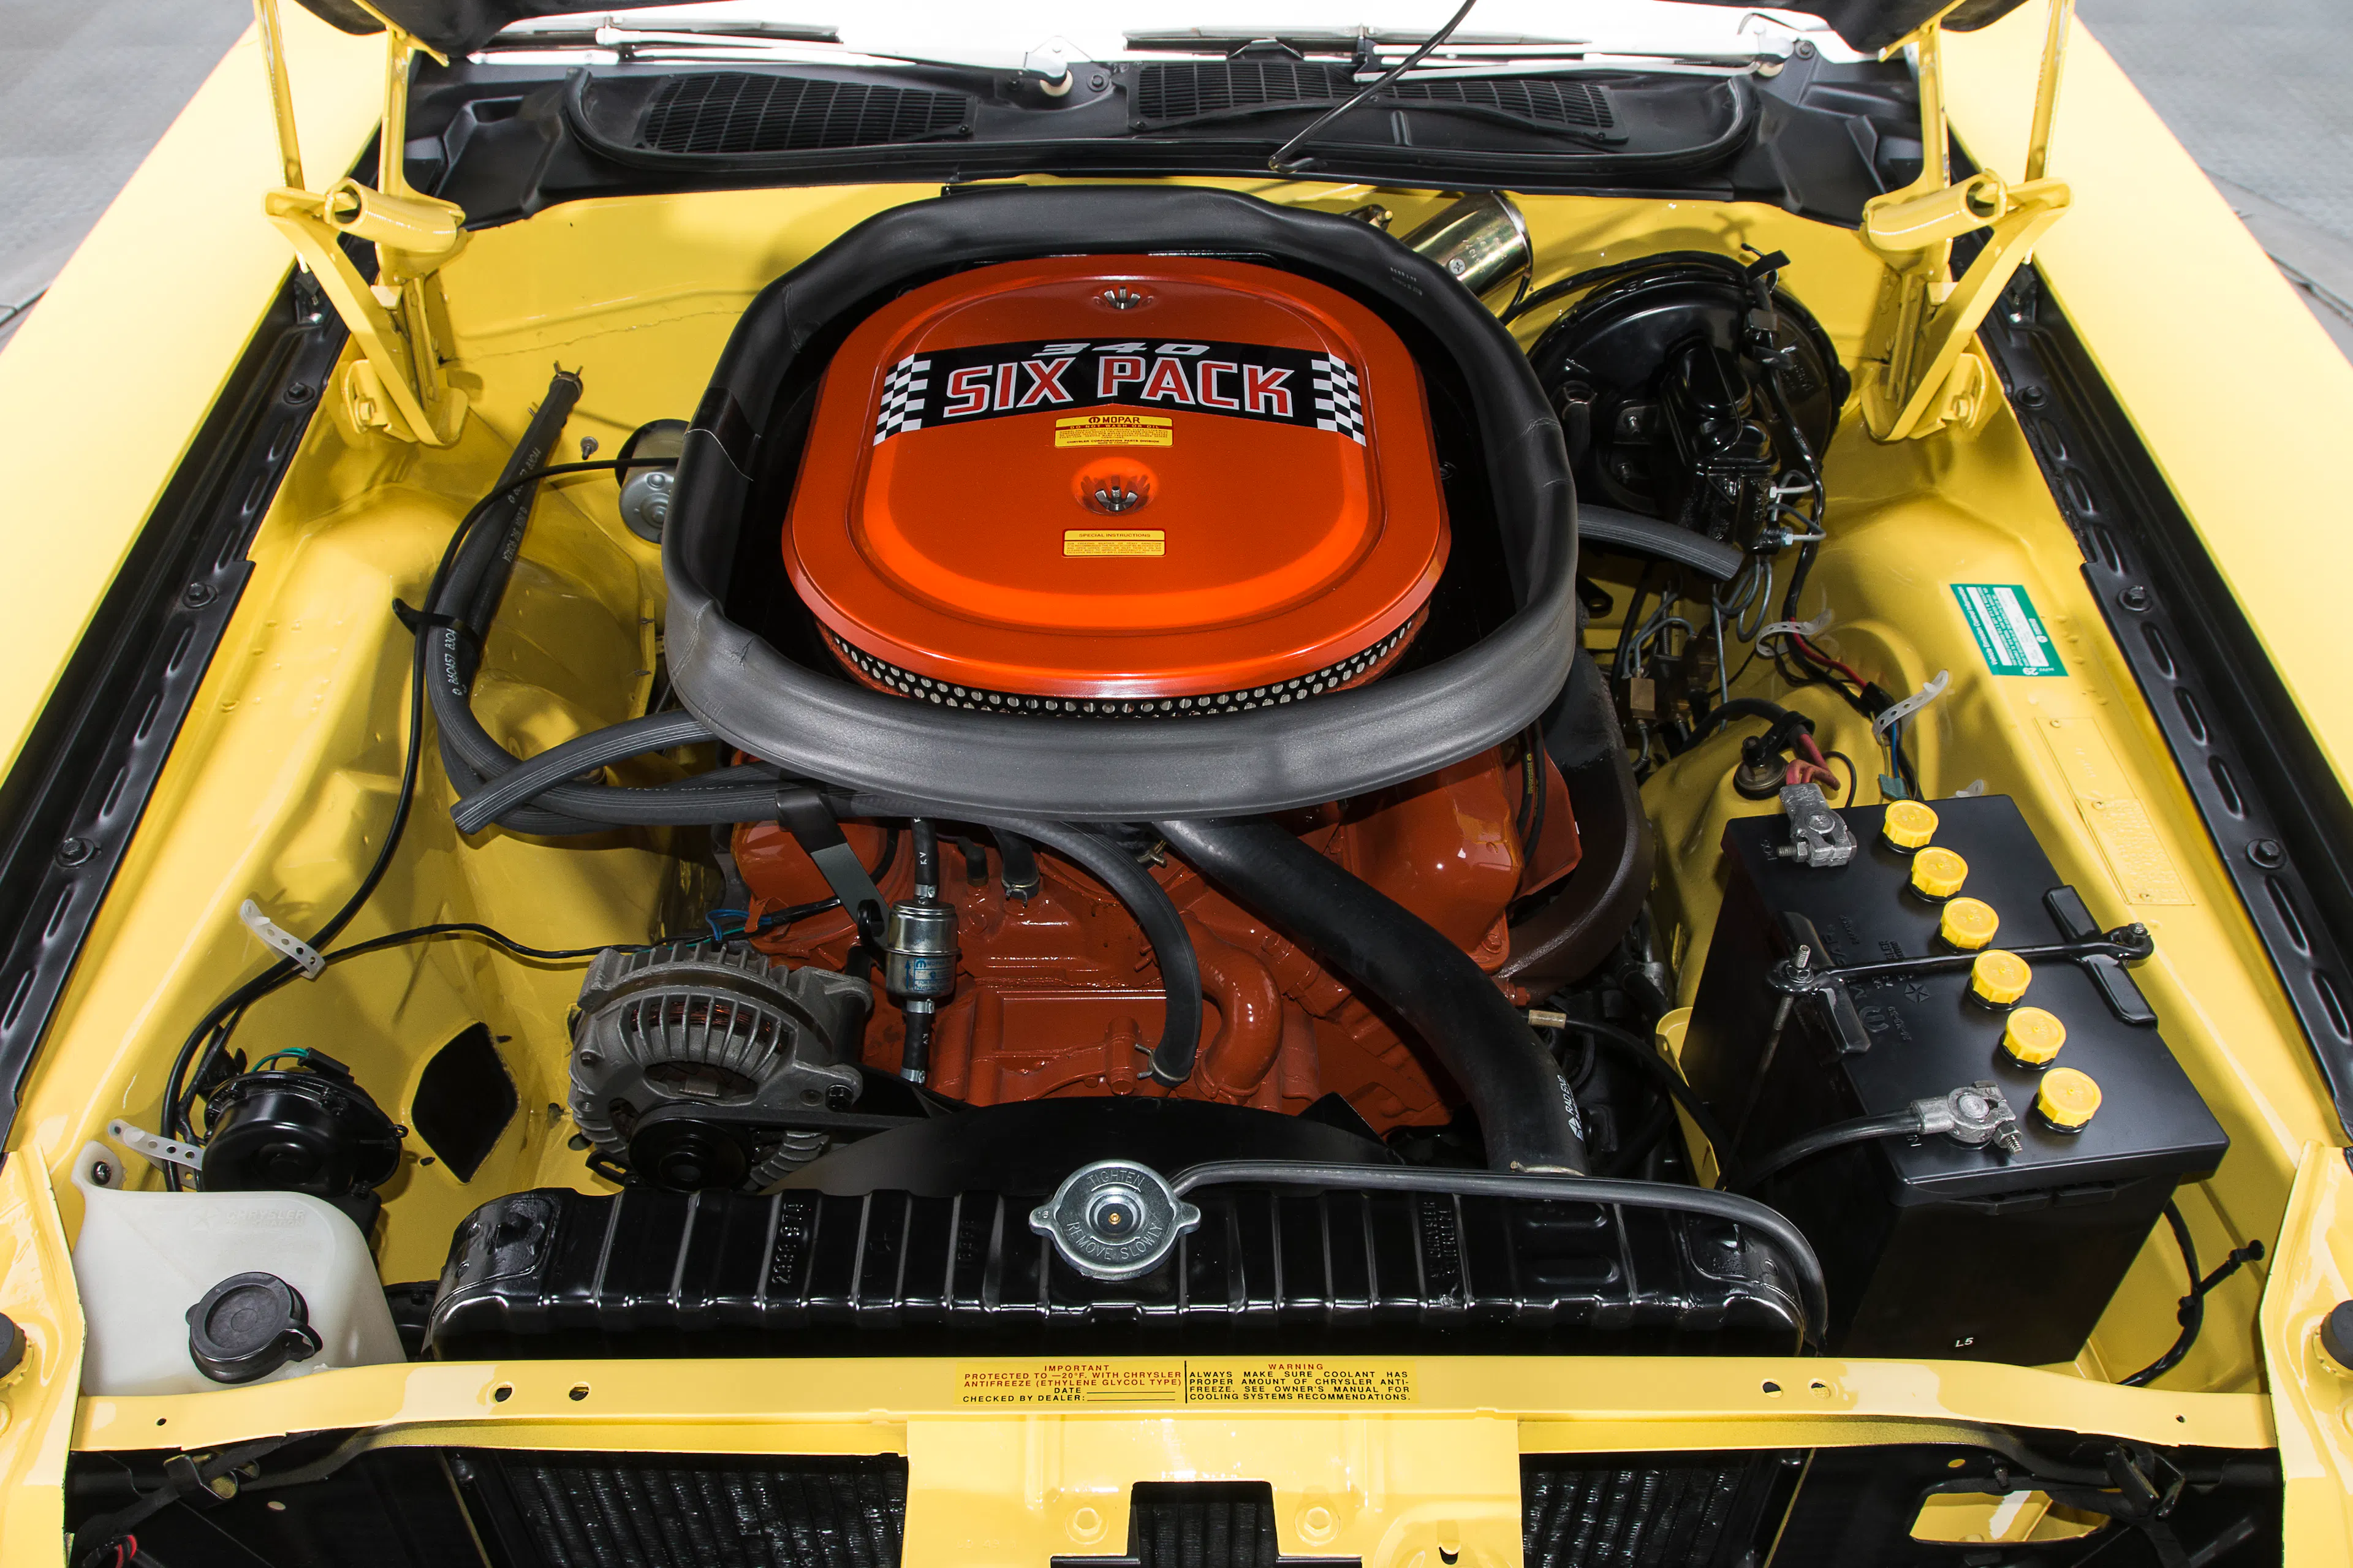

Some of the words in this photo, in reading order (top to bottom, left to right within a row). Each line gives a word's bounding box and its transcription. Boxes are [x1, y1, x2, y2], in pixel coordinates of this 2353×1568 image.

[1032, 343, 1210, 356] 340
[944, 357, 1074, 419] SIX
[1103, 355, 1294, 419] PACK
[919, 851, 927, 865] KV
[1557, 1075, 1570, 1094] END
[1563, 1093, 1574, 1115] RAD
[1087, 1170, 1145, 1187] TIGHTEN
[226, 1208, 307, 1220] CHRYSLER
[1067, 1222, 1113, 1260] REMOVE
[1120, 1222, 1162, 1260] SLOWLY
[1955, 1338, 1974, 1347] L5
